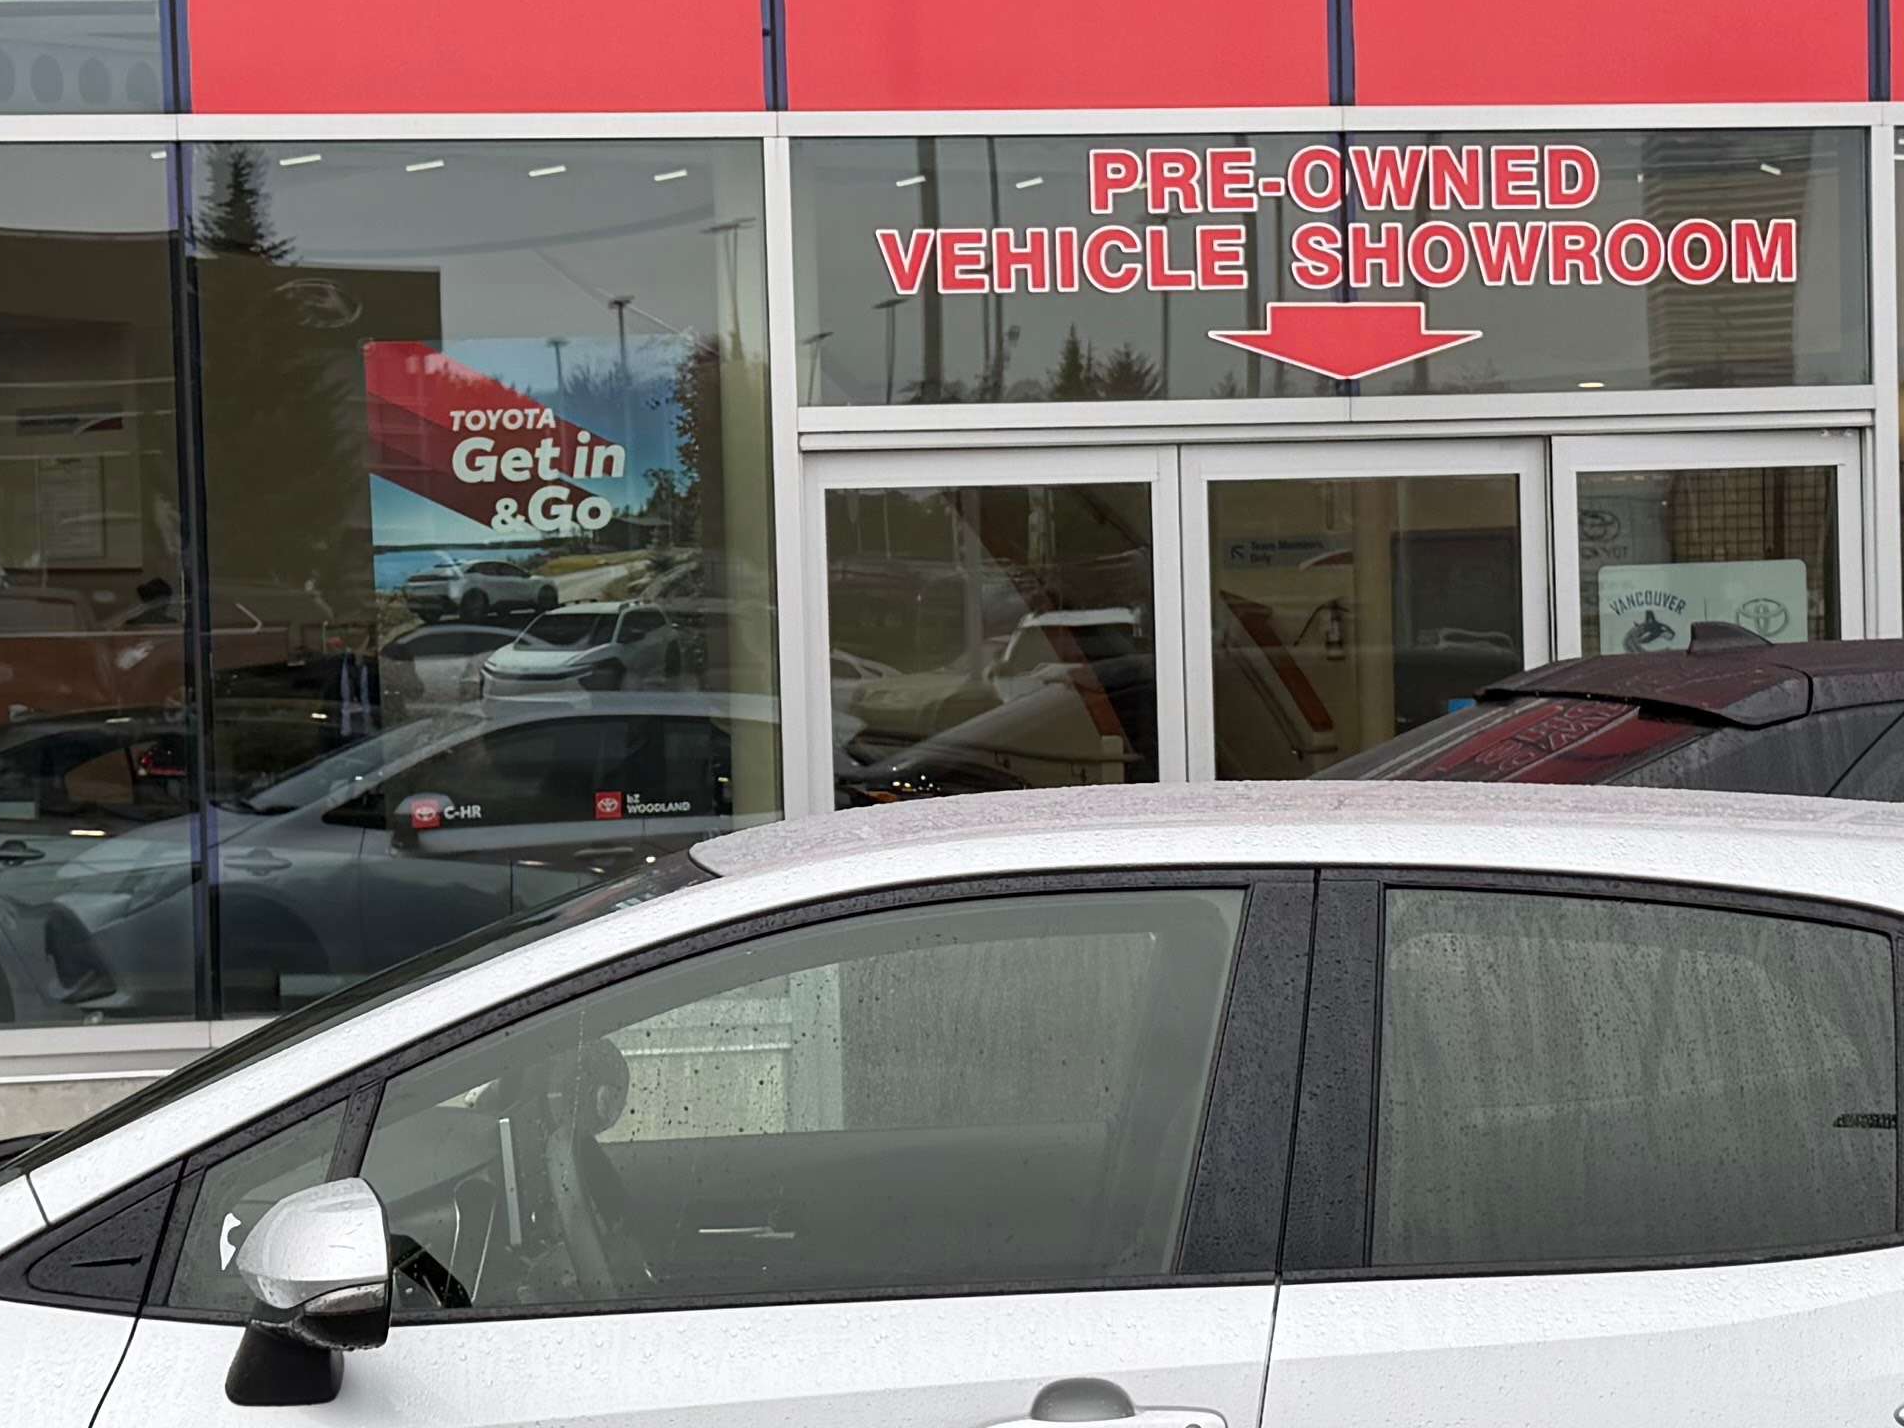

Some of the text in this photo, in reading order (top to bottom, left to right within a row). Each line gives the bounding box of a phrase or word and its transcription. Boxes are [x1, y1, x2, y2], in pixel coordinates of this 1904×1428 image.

[1087, 143, 1600, 216] PRE-OWNED
[875, 217, 1799, 297] VEHICLE SHOWROOM
[449, 406, 557, 432] TOYOTA
[451, 429, 626, 485] Get in
[1609, 589, 1687, 617] VANCOUVER
[443, 804, 483, 821] C-HR
[626, 801, 691, 814] WOODLAND
